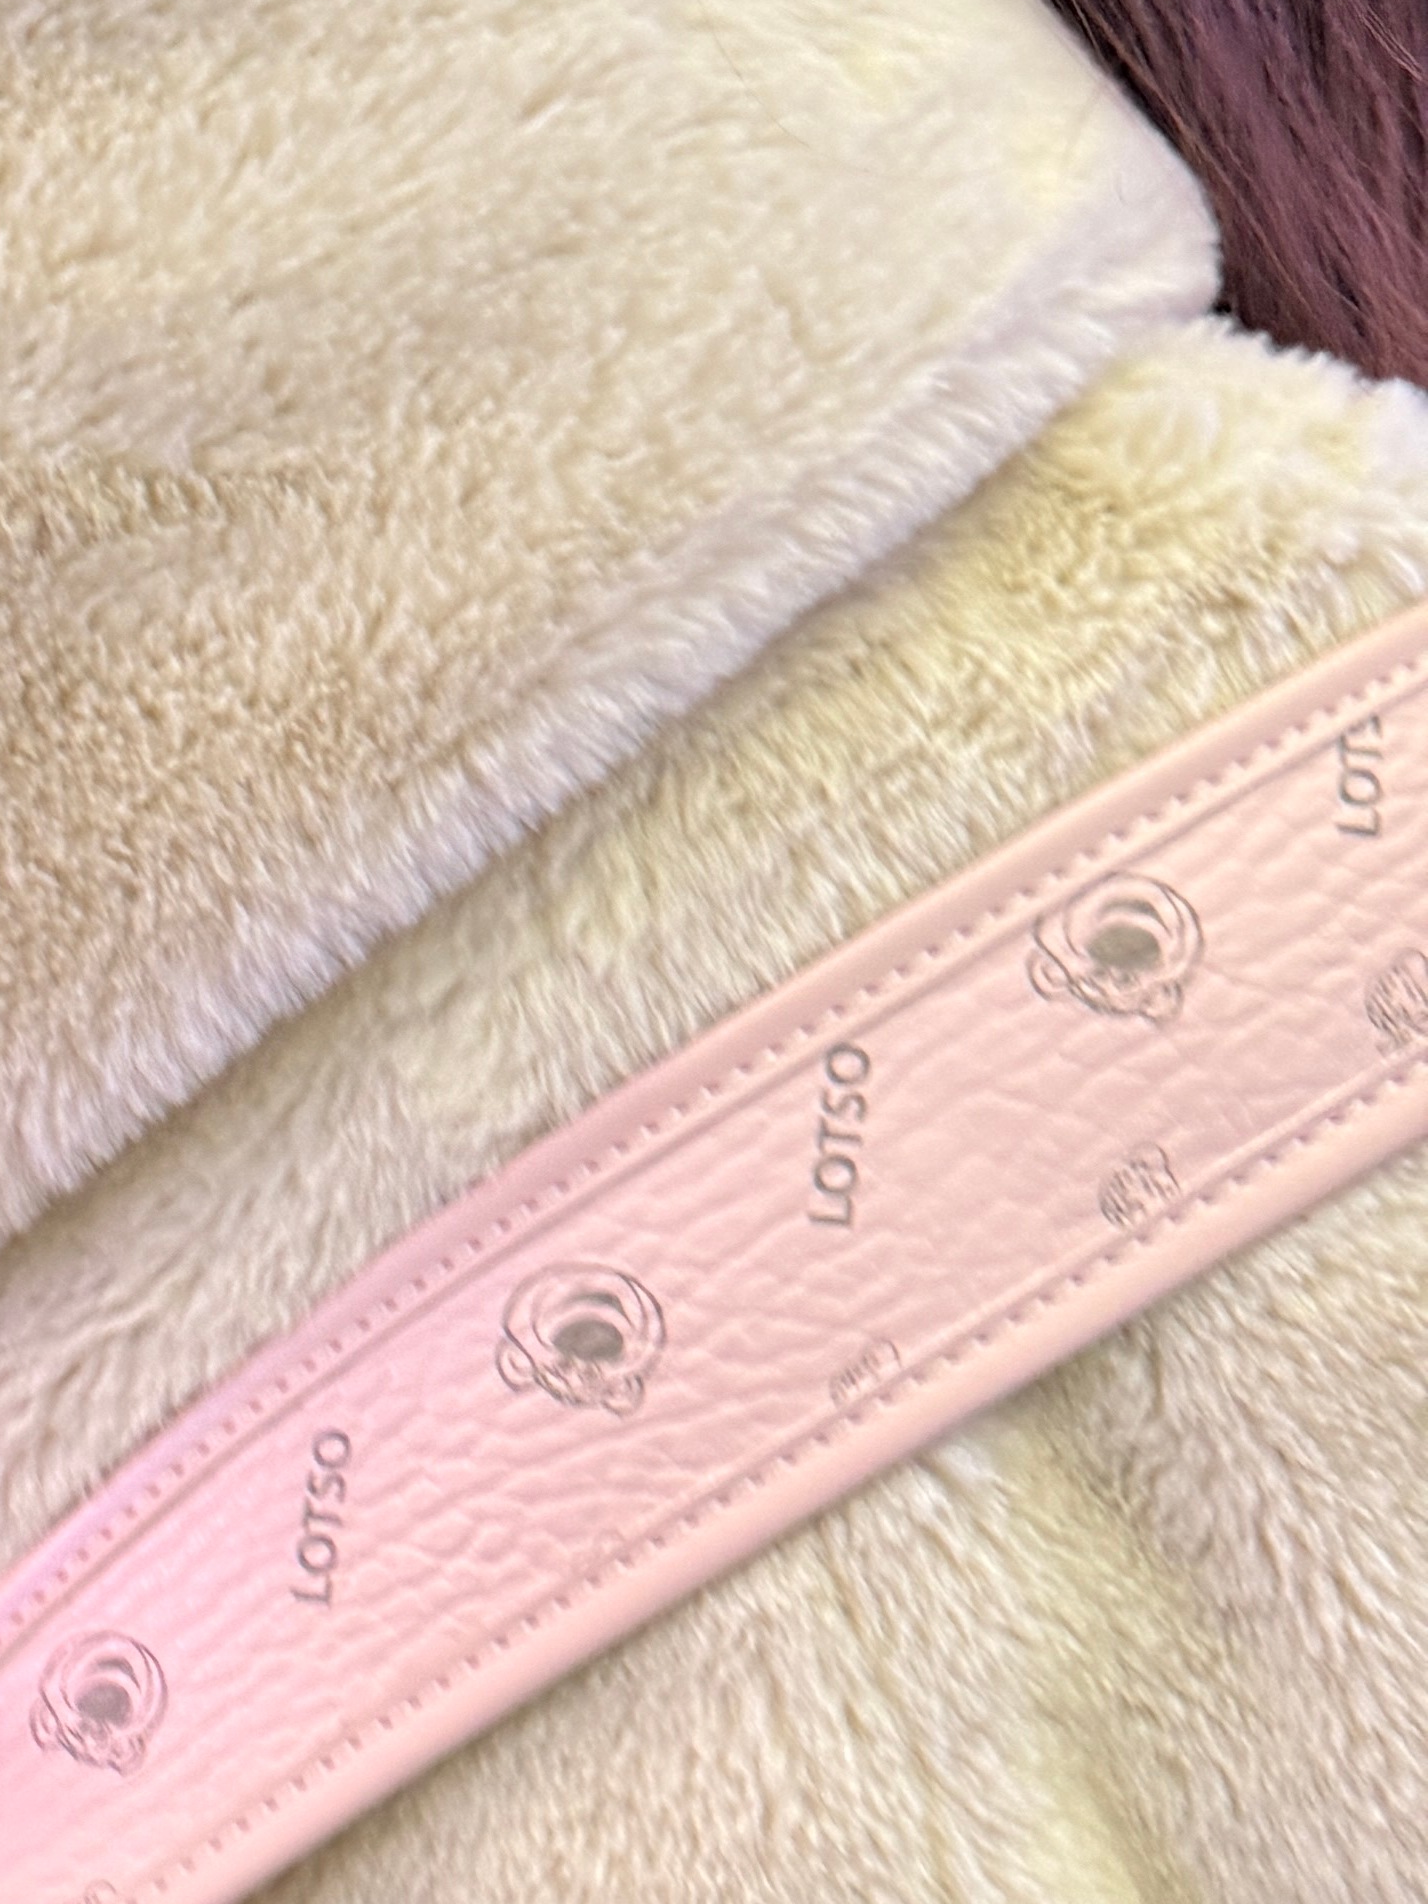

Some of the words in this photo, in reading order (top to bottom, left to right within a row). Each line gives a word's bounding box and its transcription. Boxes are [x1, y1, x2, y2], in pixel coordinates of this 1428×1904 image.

[1337, 713, 1383, 838] LOTS
[808, 1040, 872, 1229] LOTSO
[290, 1428, 352, 1607] LOTSO
